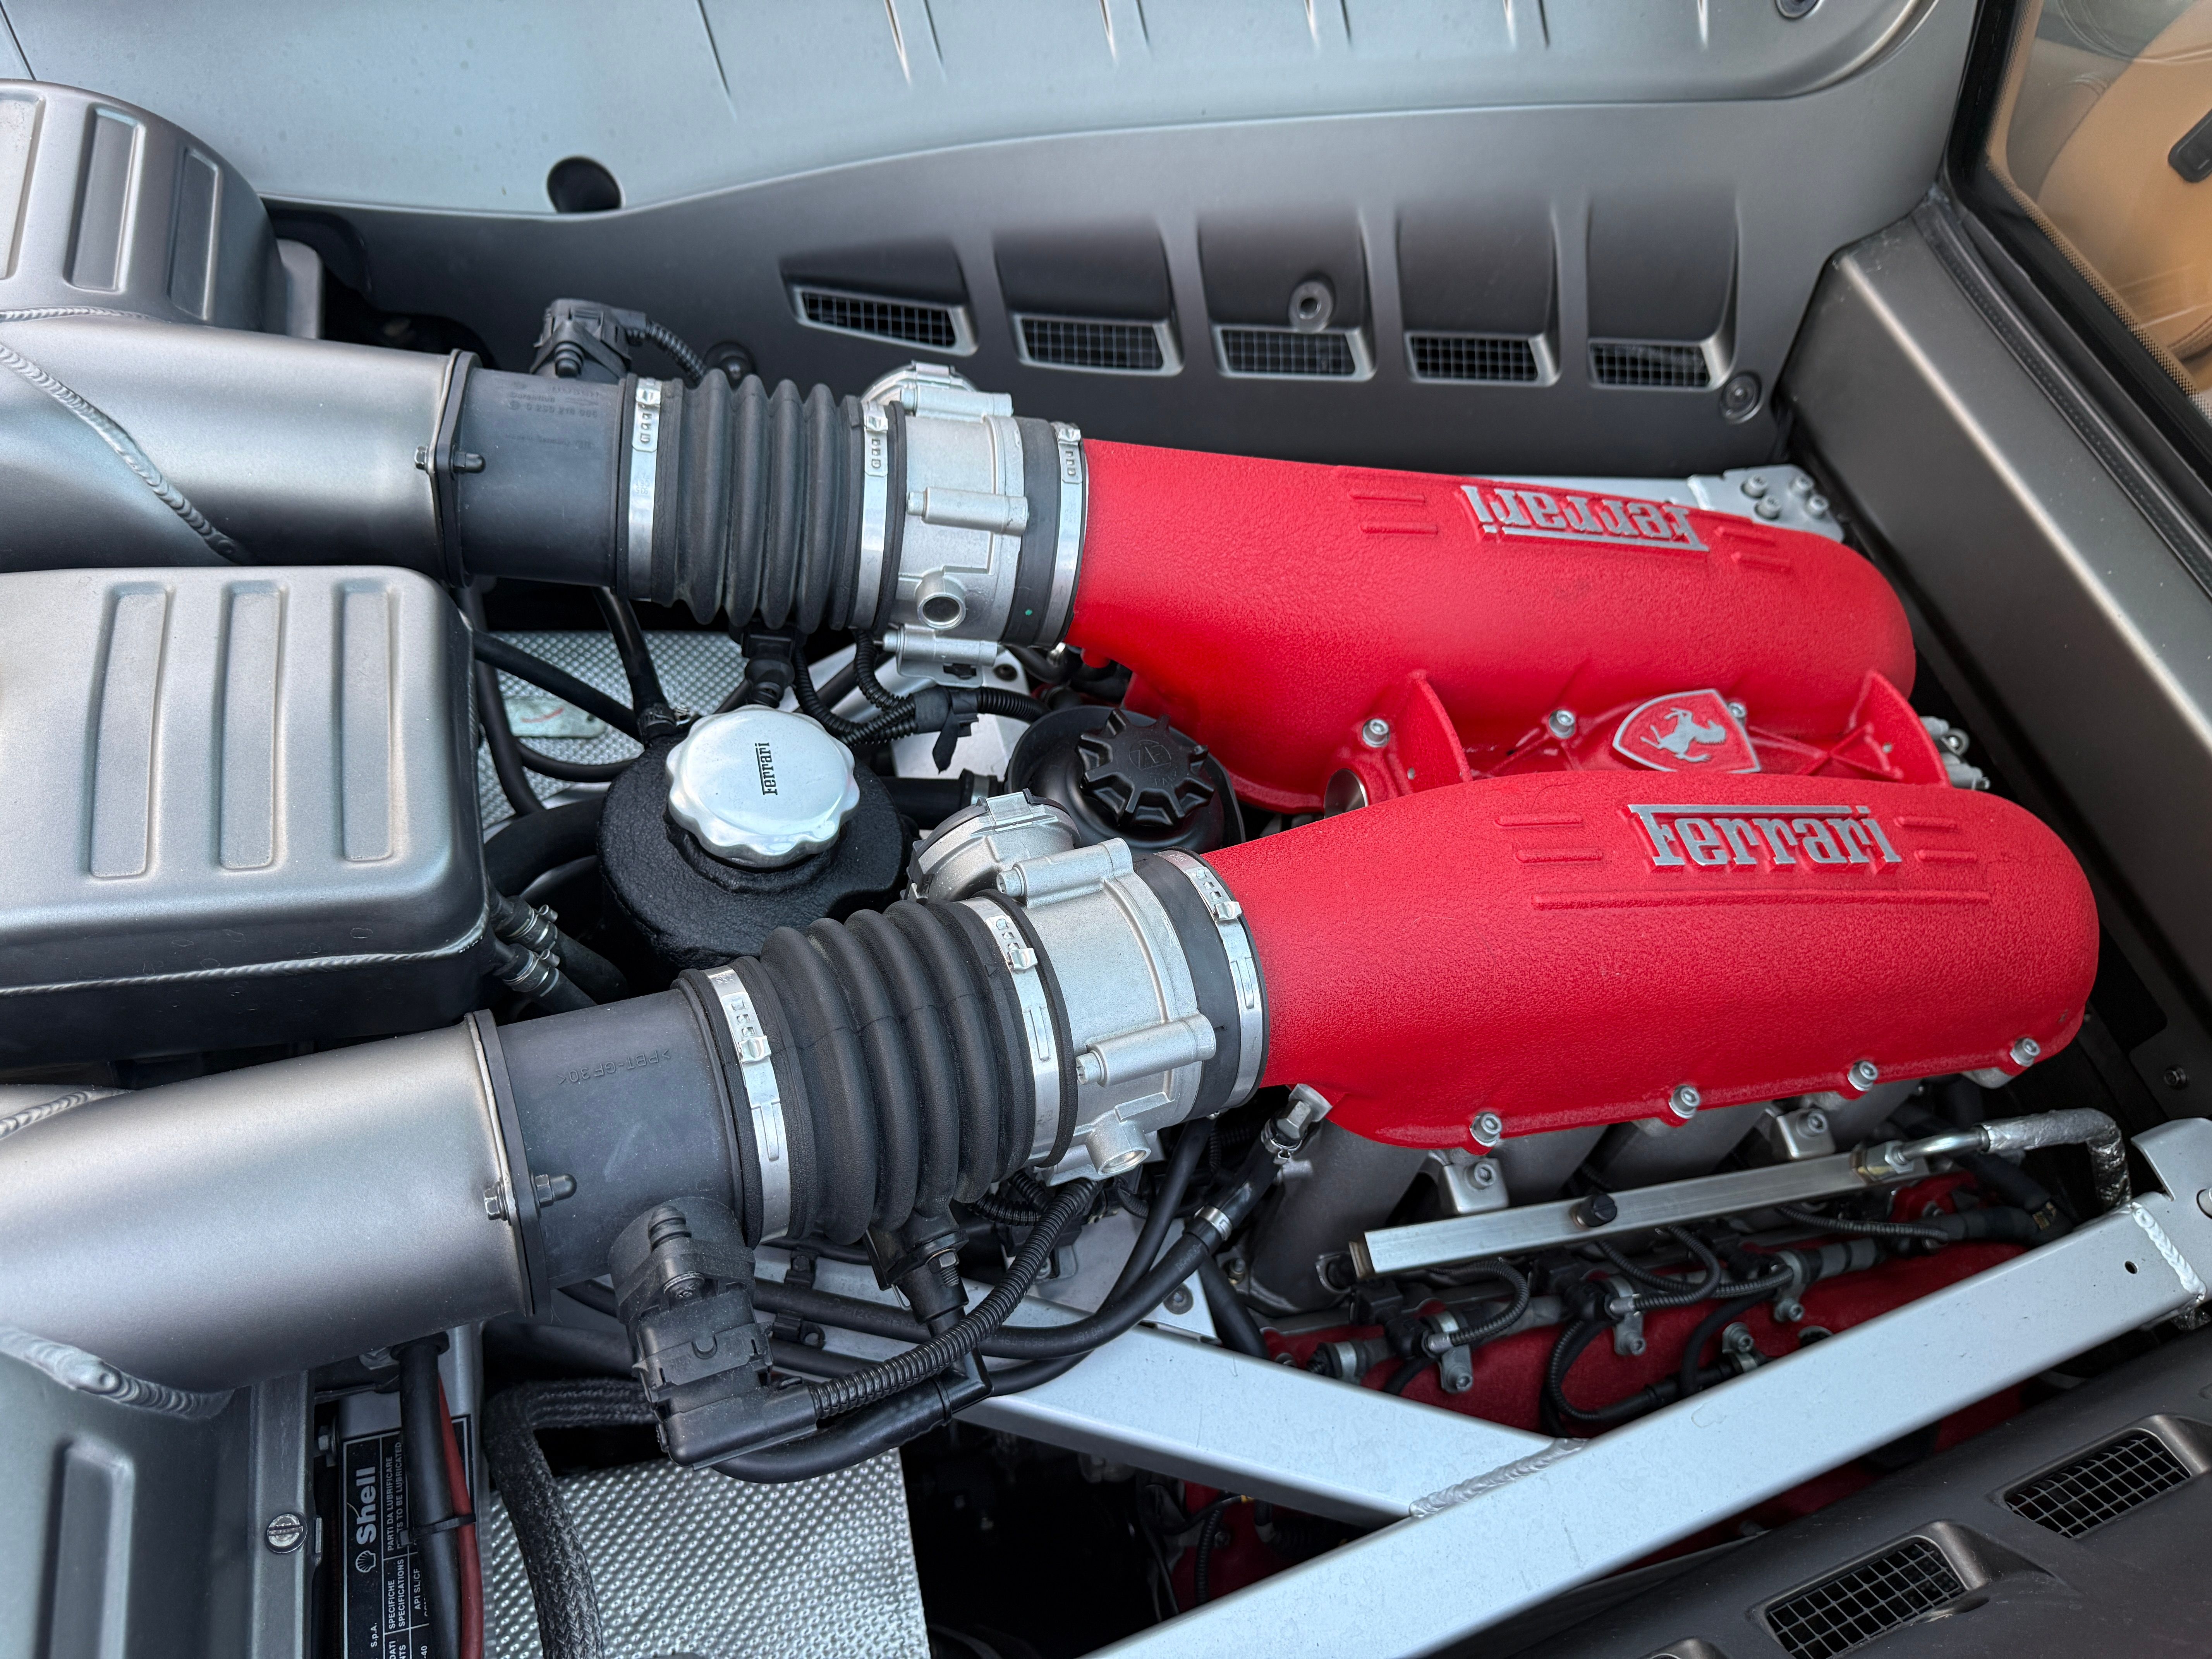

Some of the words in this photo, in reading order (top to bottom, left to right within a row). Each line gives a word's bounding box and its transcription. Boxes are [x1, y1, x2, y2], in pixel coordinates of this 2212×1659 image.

[1461, 485, 1709, 552] Ferrari
[755, 742, 778, 795] Ferrari
[1628, 804, 1902, 866] Ferrari
[395, 1442, 403, 1492] LUBRICATED
[356, 1466, 376, 1545] Shell
[387, 1512, 393, 1525] DA
[396, 1494, 403, 1506] BE
[396, 1508, 403, 1520] TO
[397, 1559, 405, 1627] SPECIFICATIONS
[413, 1568, 421, 1594] SL/CF
[371, 1623, 379, 1647] S.p.A.
